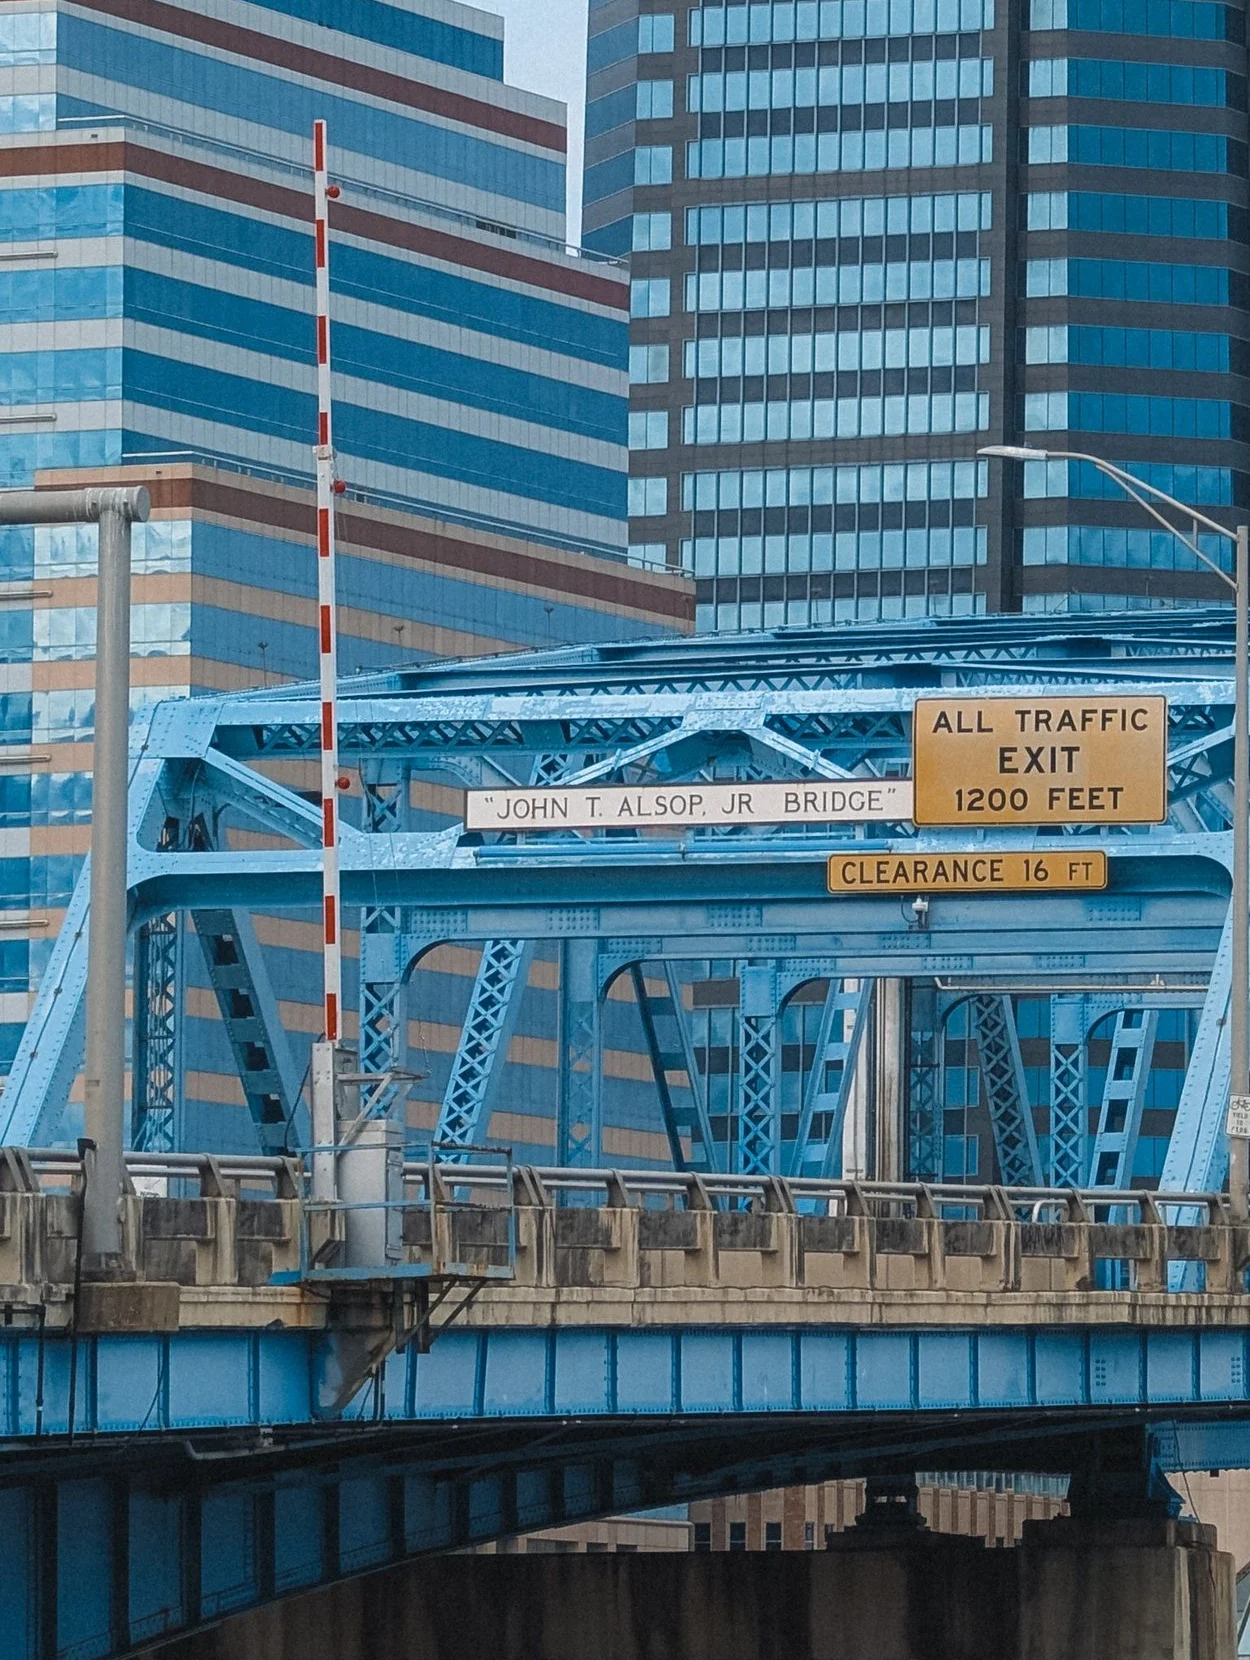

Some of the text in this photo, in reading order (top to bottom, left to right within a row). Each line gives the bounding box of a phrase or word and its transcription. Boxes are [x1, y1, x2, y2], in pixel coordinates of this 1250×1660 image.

[932, 708, 1148, 733] ALL TRAFFIC
[999, 746, 1080, 773] EXIT
[585, 795, 603, 819] T.
[721, 791, 755, 815] JR
[955, 786, 1124, 811] 1200 FEET
[841, 858, 1093, 884] CLEARANCE 16 FT
